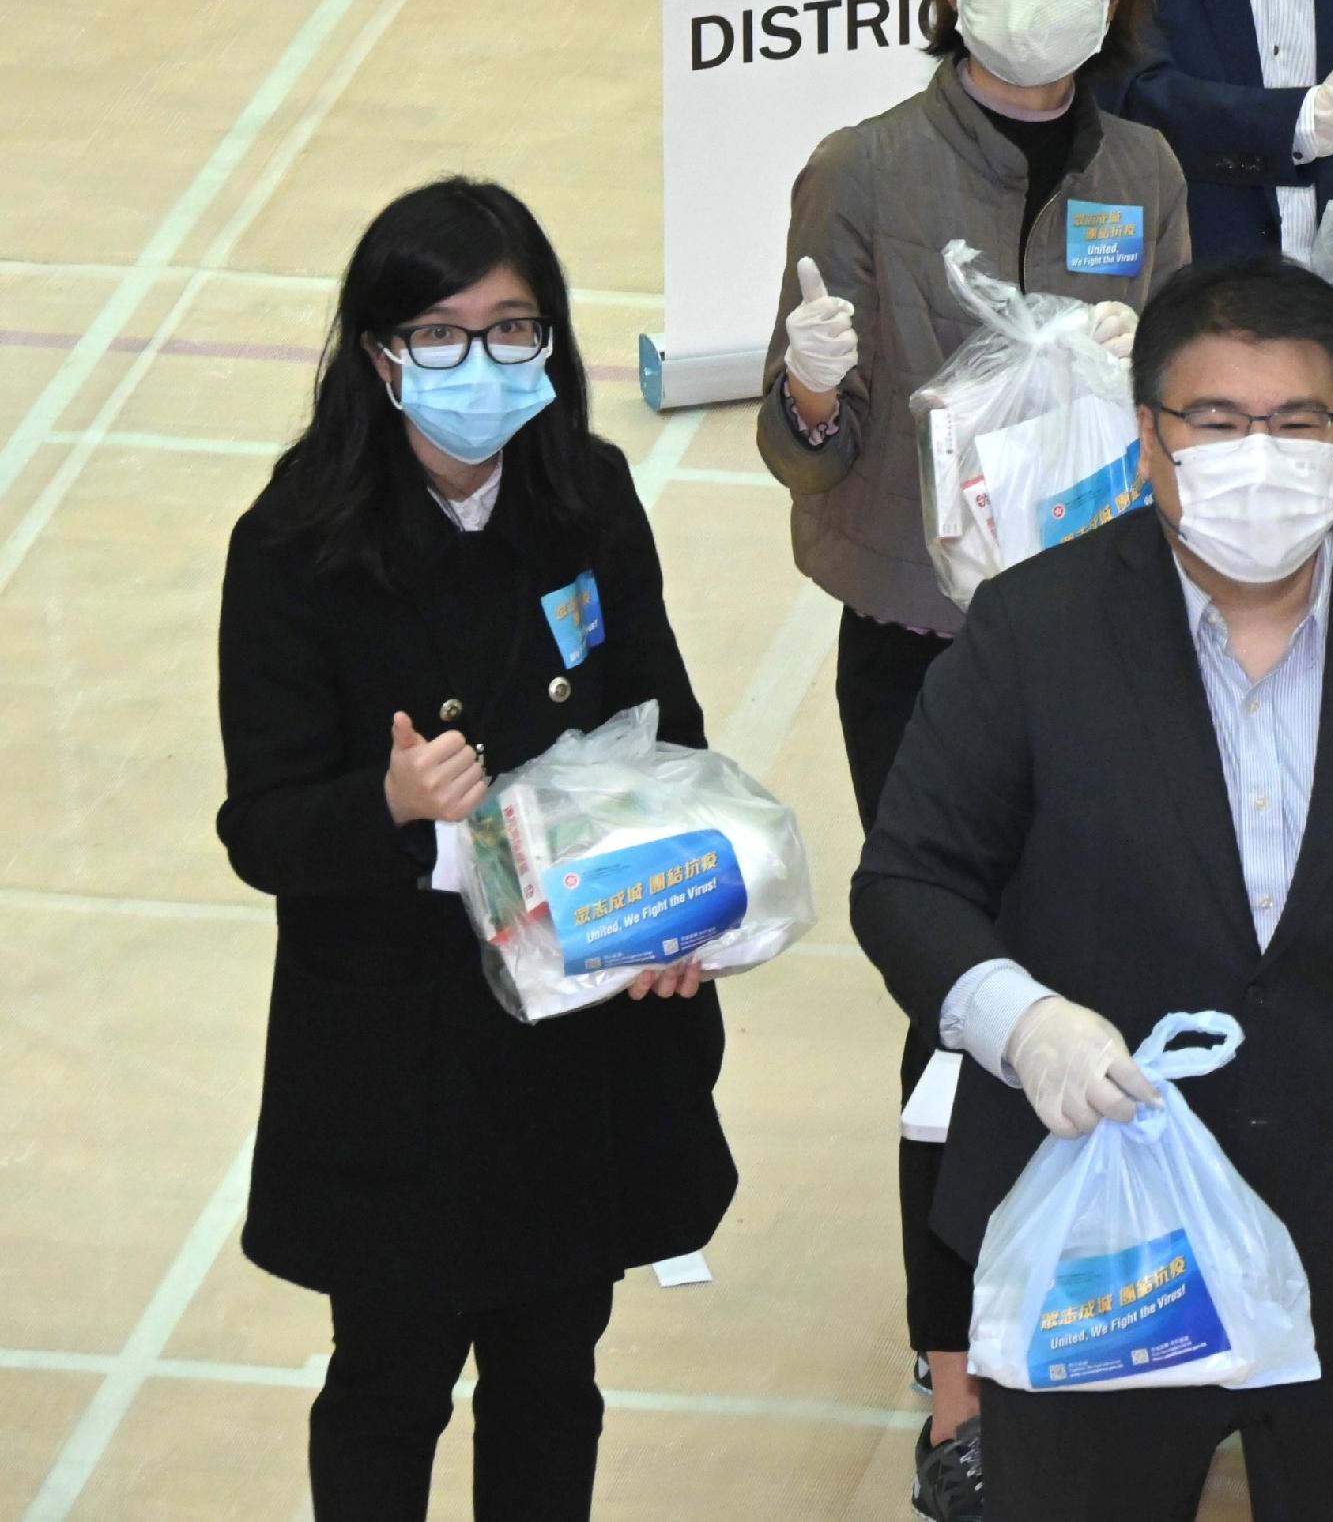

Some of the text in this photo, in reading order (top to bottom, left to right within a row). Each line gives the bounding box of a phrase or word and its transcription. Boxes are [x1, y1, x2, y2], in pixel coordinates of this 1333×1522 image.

[585, 876, 718, 944] United, We Fight the Virus!
[1050, 1332, 1089, 1350] United,
[1110, 1309, 1138, 1332] Fight
[1139, 1302, 1157, 1320] the
[1157, 1282, 1187, 1310] Virus!
